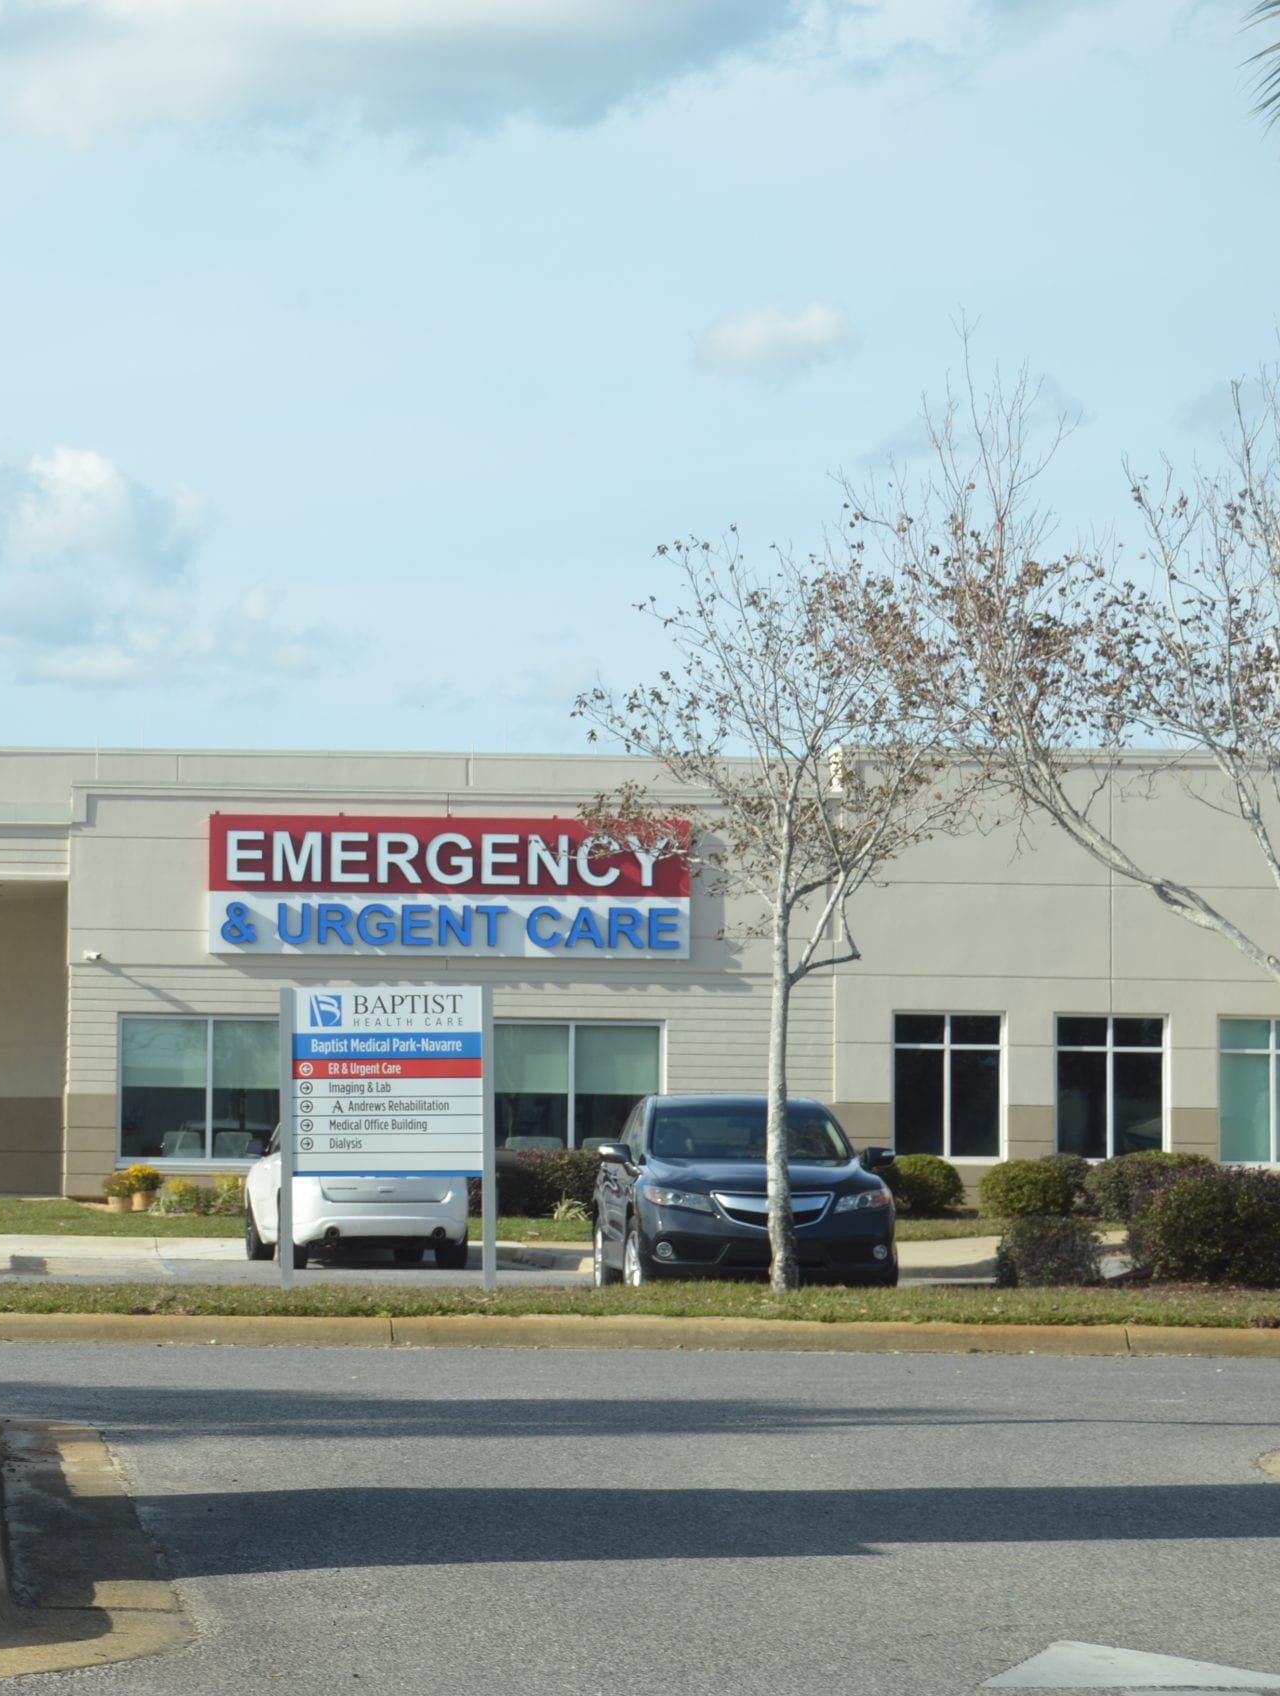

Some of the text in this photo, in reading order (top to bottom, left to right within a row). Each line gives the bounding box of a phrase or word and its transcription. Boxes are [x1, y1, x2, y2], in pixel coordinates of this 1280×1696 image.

[226, 829, 670, 888] EMERGENCY
[220, 901, 682, 950] & URGENT CARE
[353, 994, 463, 1015] BAPTIST
[353, 1016, 463, 1027] HEALTH CARE
[311, 1037, 463, 1055] Baptist Medical Park-Navarre
[328, 1062, 401, 1076] ER & Urgent Care
[328, 1082, 392, 1095] Imaging & Lab
[348, 1100, 386, 1112] Andrews
[388, 1100, 450, 1111] Rehabilitation
[329, 1118, 428, 1132] Medical Office Building
[329, 1137, 363, 1150] Dialysis
